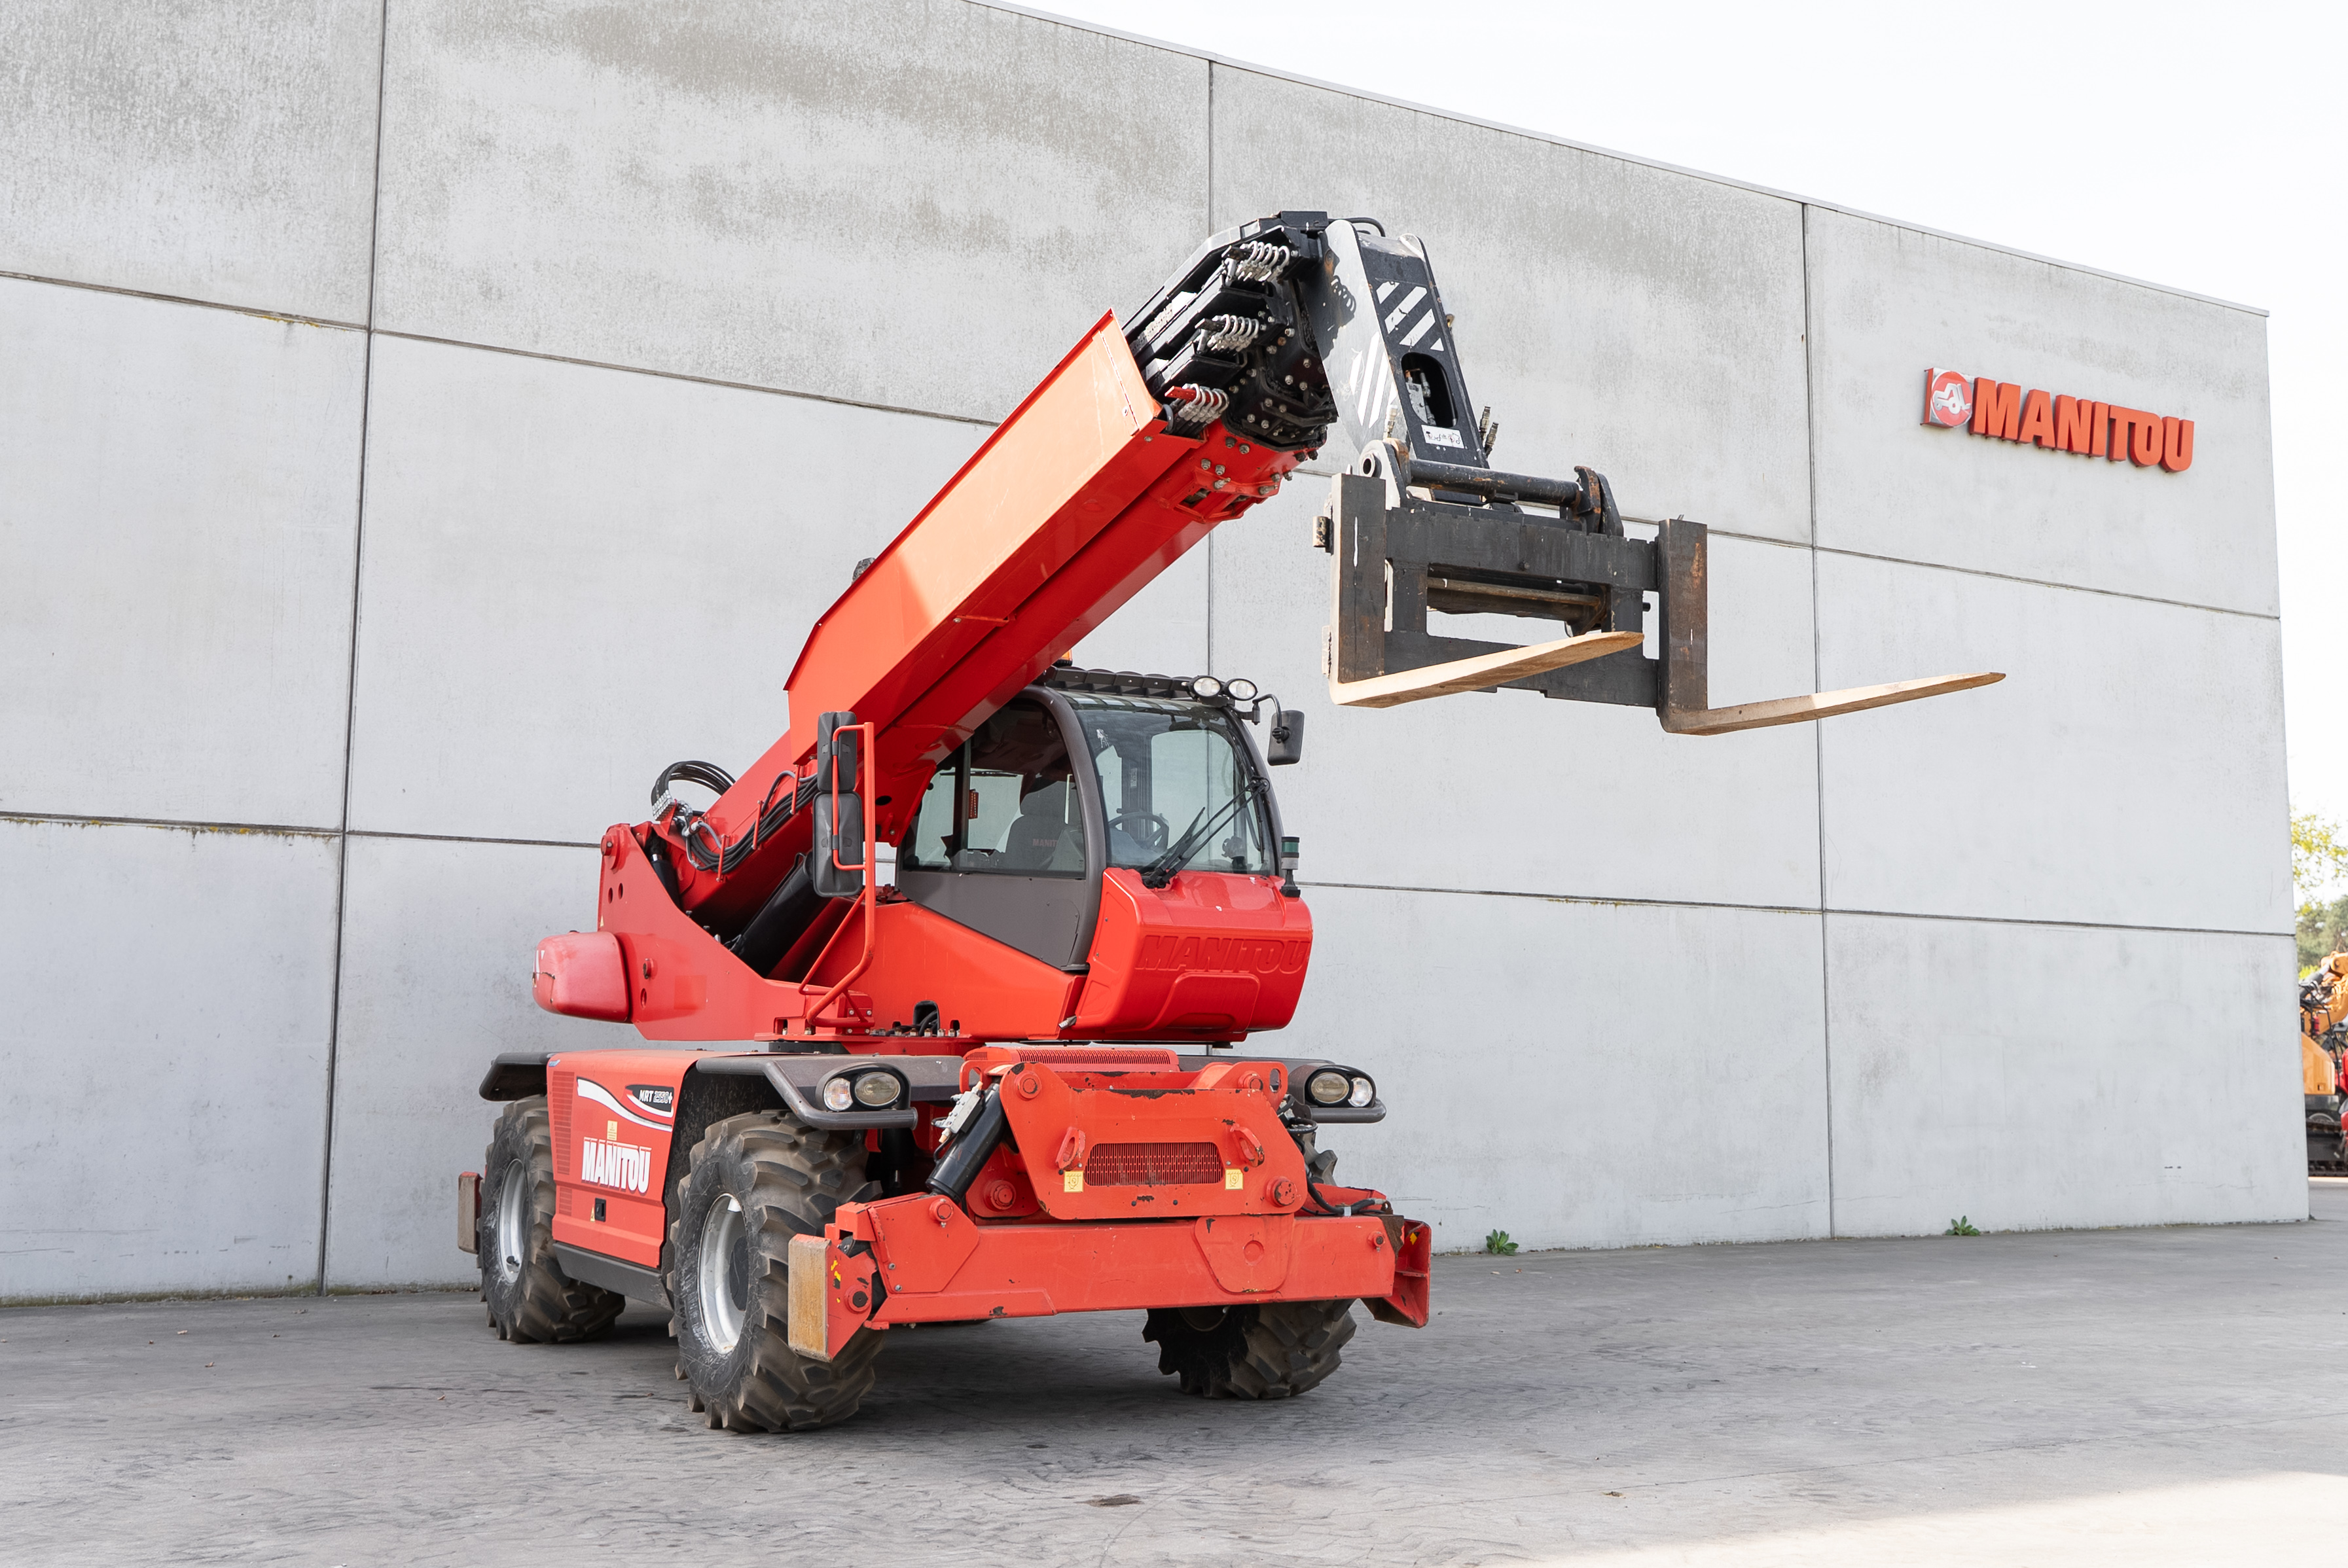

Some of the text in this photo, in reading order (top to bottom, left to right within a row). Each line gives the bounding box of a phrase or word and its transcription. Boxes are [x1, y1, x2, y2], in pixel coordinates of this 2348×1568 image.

[1969, 377, 2194, 472] MANITOU
[1032, 838, 1058, 847] MANIT
[1134, 935, 1310, 974] MANITOU
[639, 1089, 654, 1103] MRT
[581, 1137, 651, 1194] MANITOU
